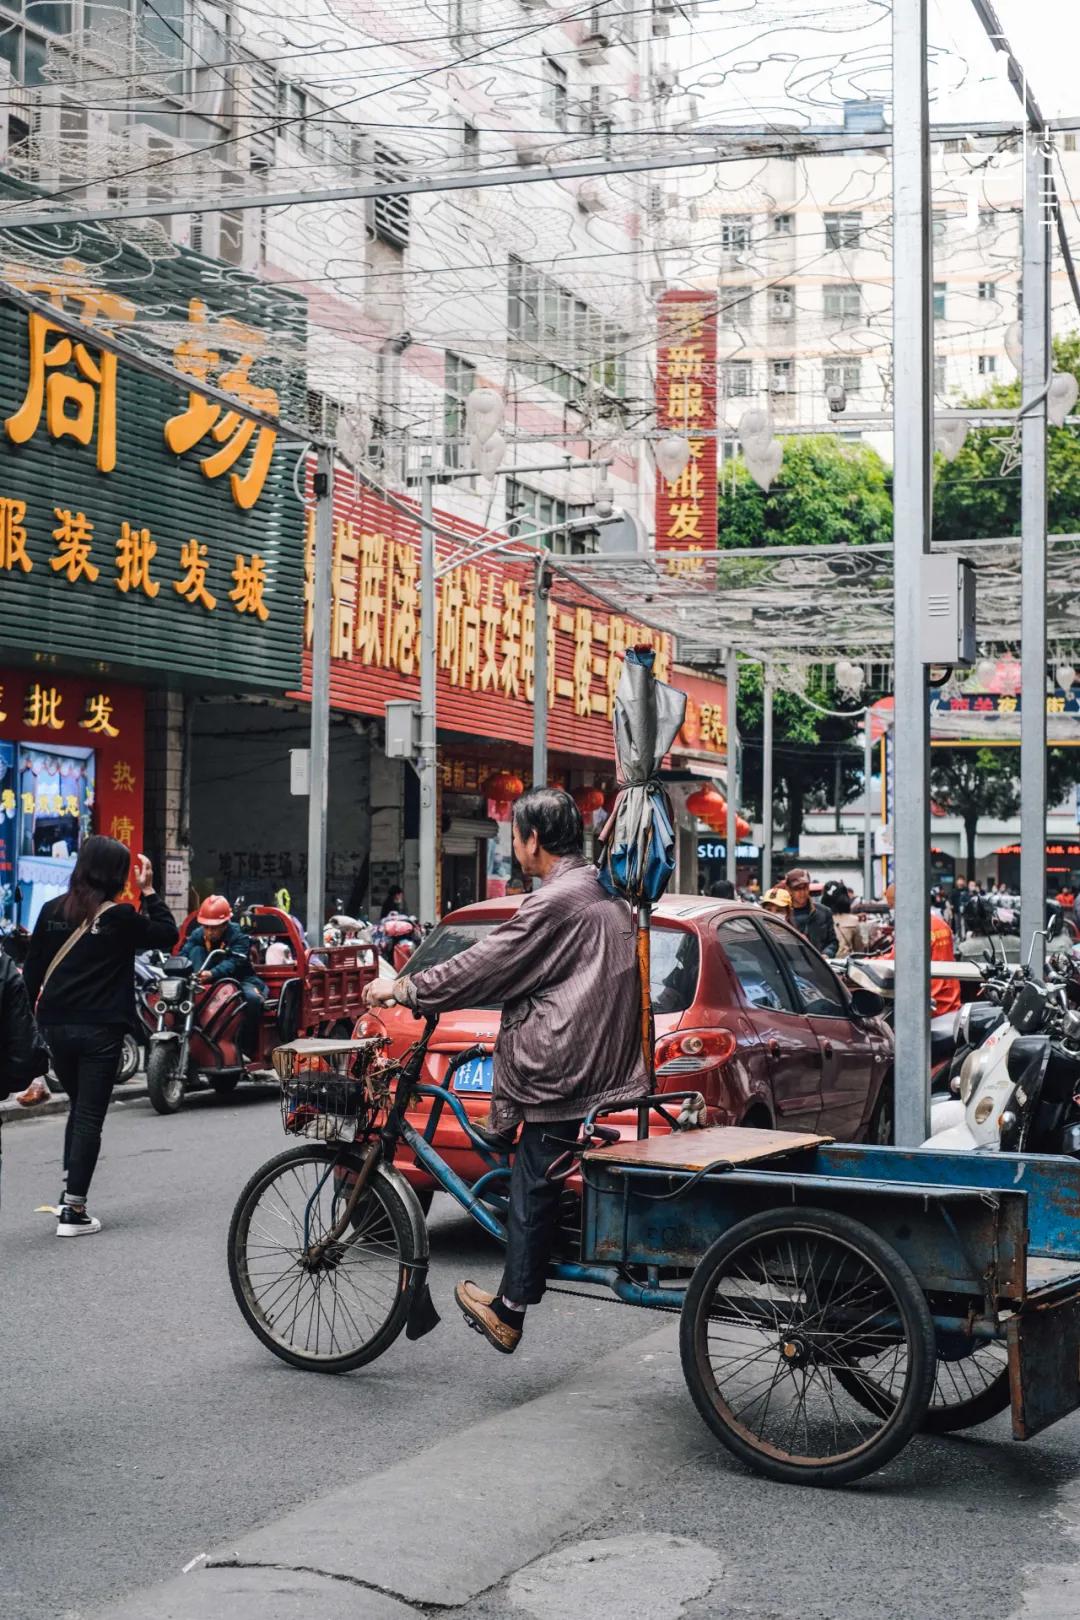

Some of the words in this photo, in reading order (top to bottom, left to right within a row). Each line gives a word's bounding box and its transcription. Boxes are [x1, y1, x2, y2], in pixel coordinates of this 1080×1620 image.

[0, 497, 269, 622] 服装批发城
